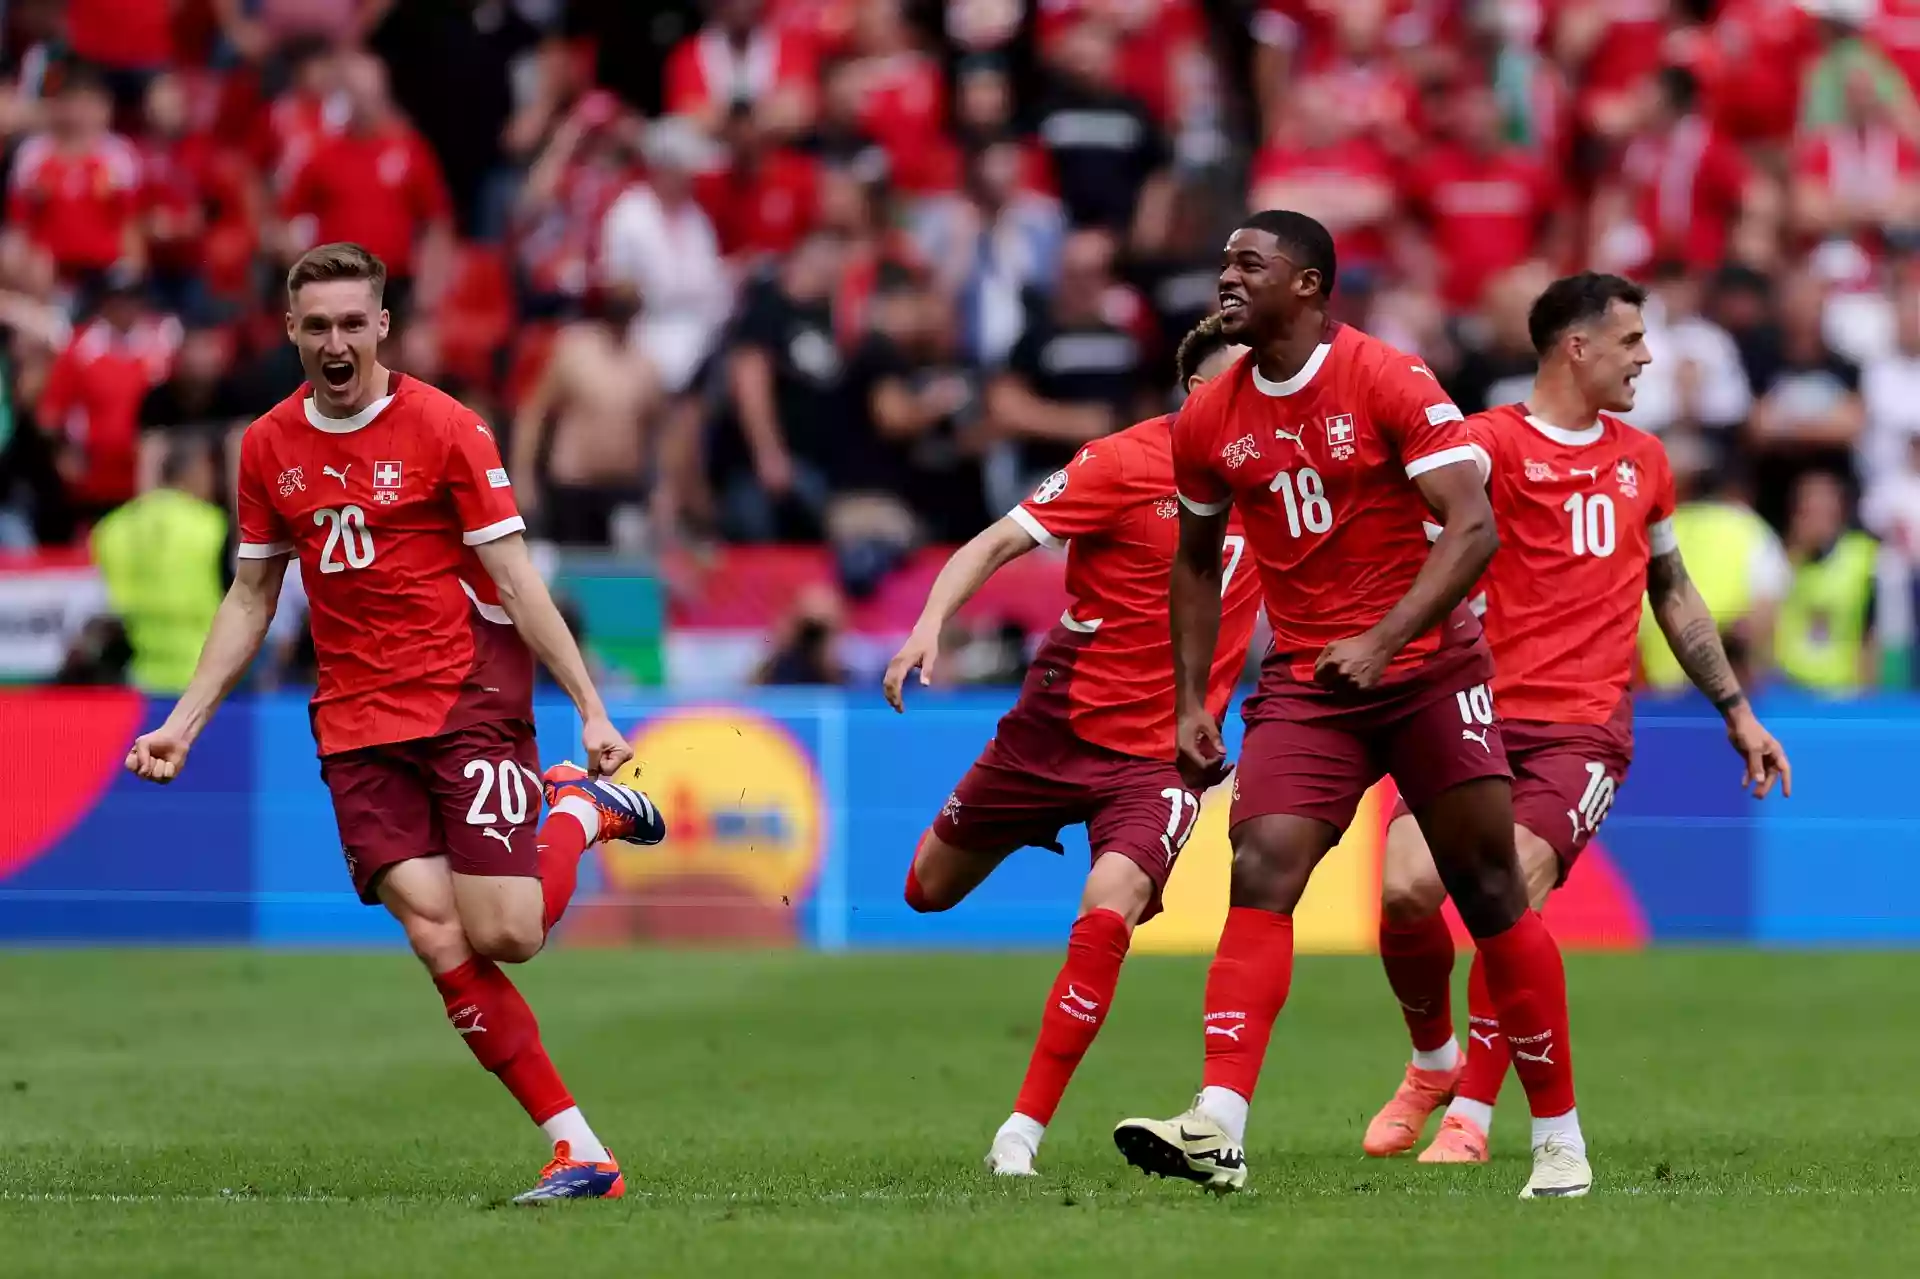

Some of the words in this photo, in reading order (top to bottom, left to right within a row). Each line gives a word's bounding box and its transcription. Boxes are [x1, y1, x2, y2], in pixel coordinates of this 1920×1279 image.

[1269, 467, 1333, 538] 18
[1564, 492, 1616, 558] 10
[313, 505, 376, 574] 20
[1221, 535, 1245, 598] 7
[463, 759, 527, 825] 20
[1160, 787, 1199, 849] 17
[1578, 761, 1615, 832] 10
